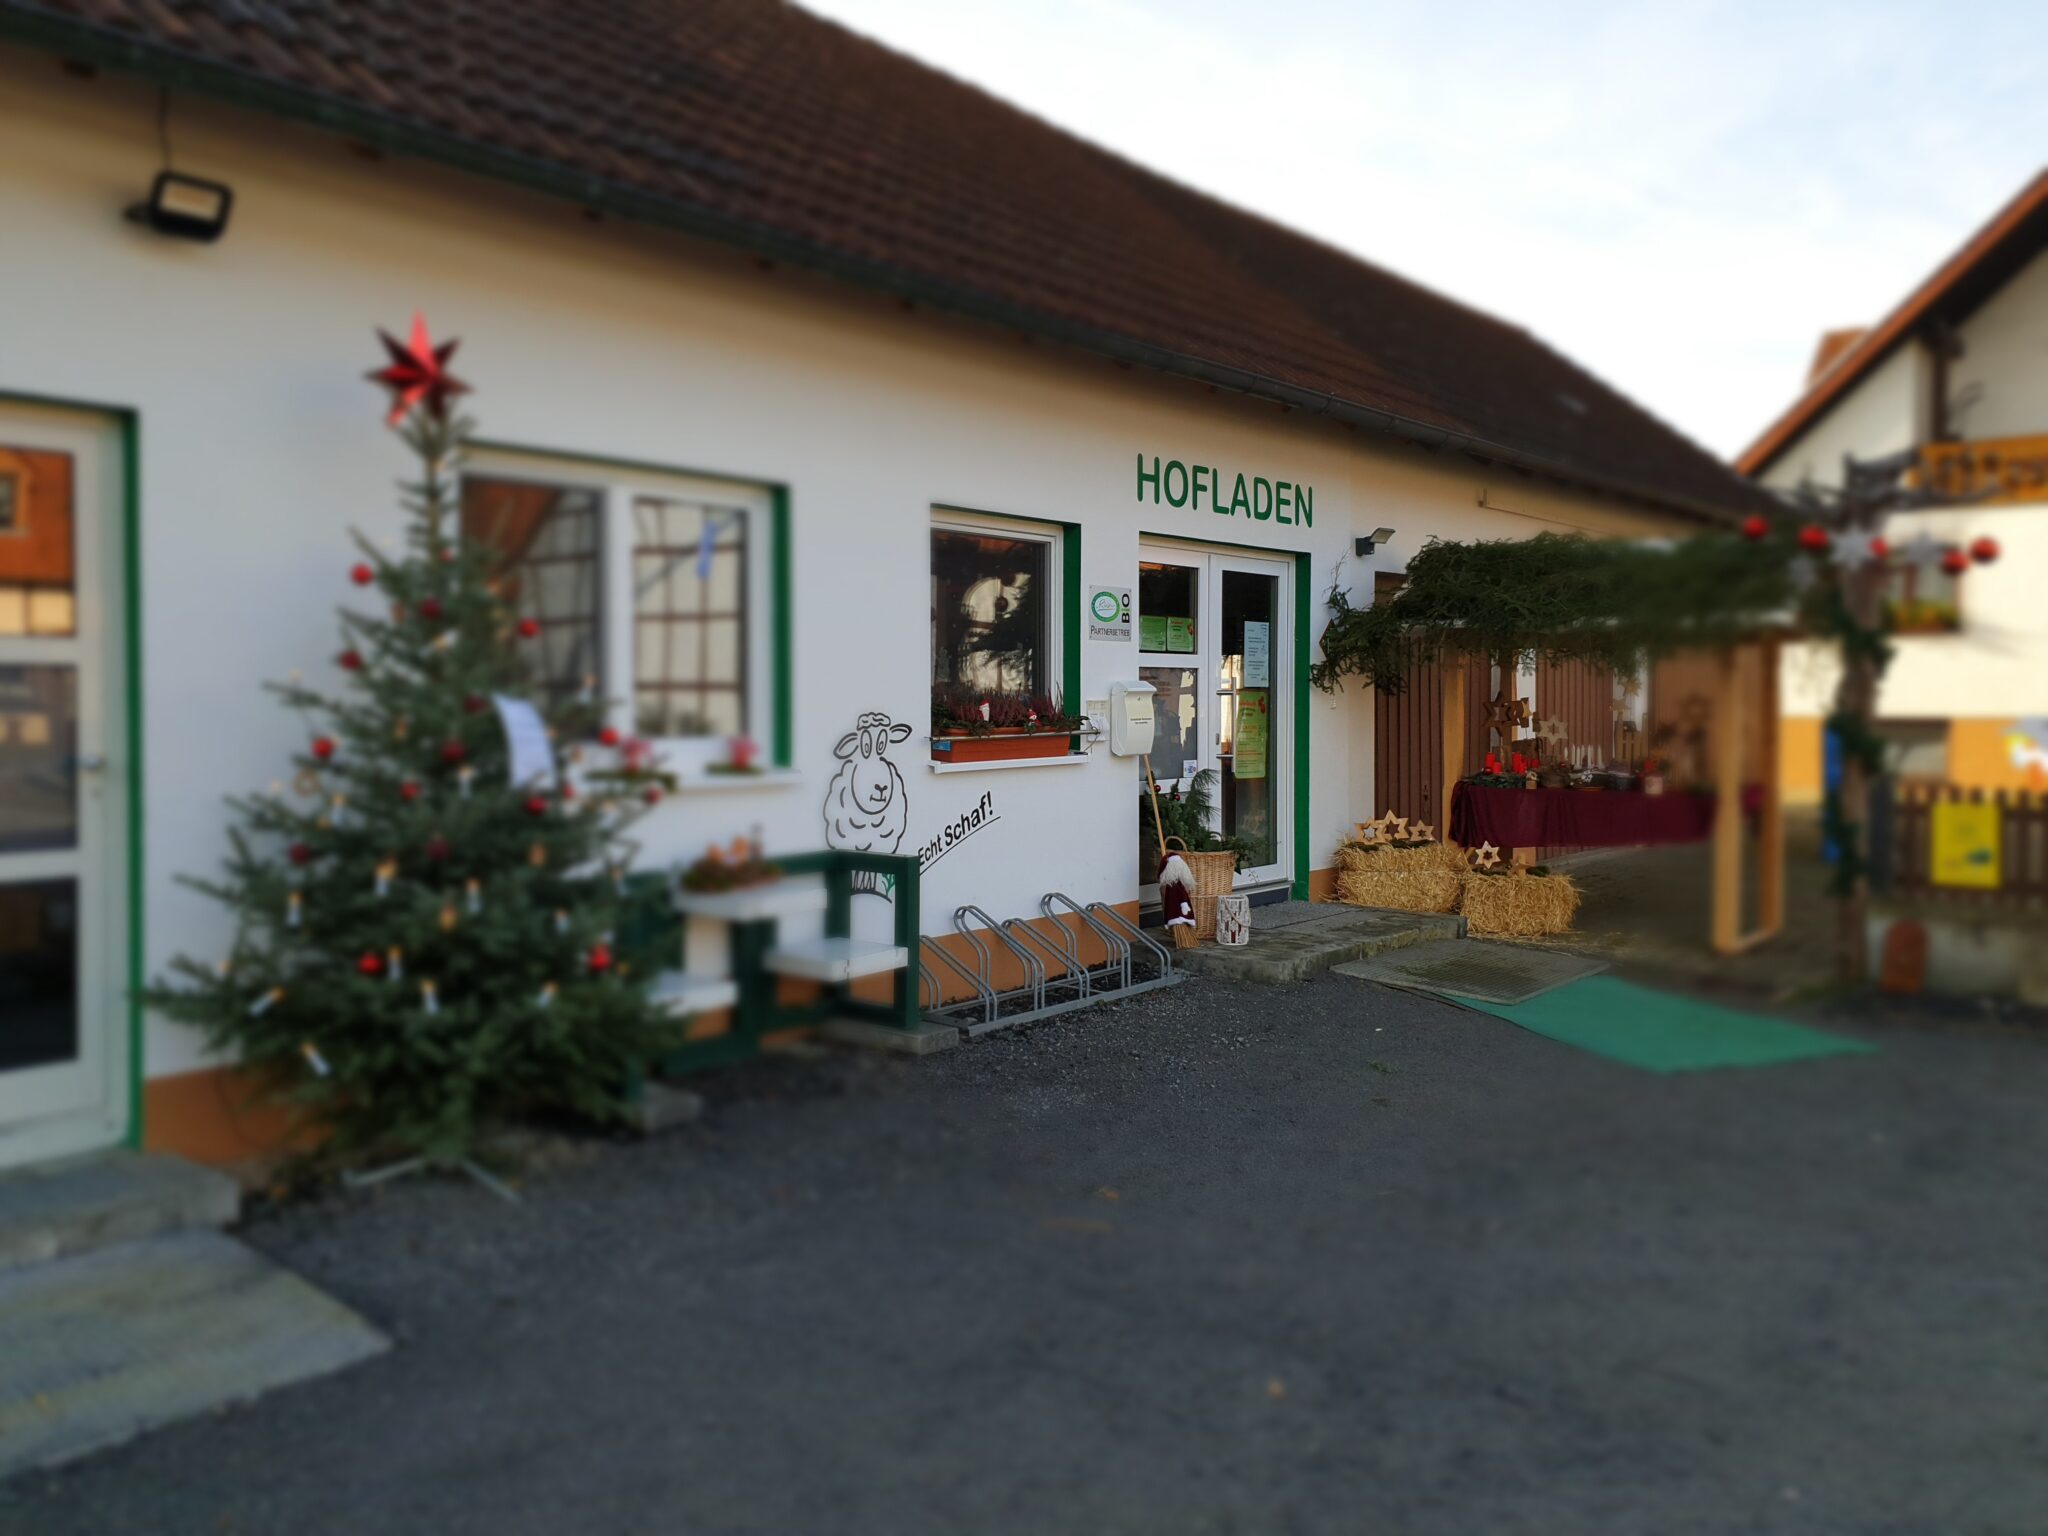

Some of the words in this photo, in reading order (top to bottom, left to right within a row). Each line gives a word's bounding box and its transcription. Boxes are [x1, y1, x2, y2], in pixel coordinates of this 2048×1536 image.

[1137, 453, 1313, 529] HOFLADEN
[1121, 593, 1130, 623] BIO
[918, 834, 943, 866] Echt
[944, 790, 993, 847] Schaf!
